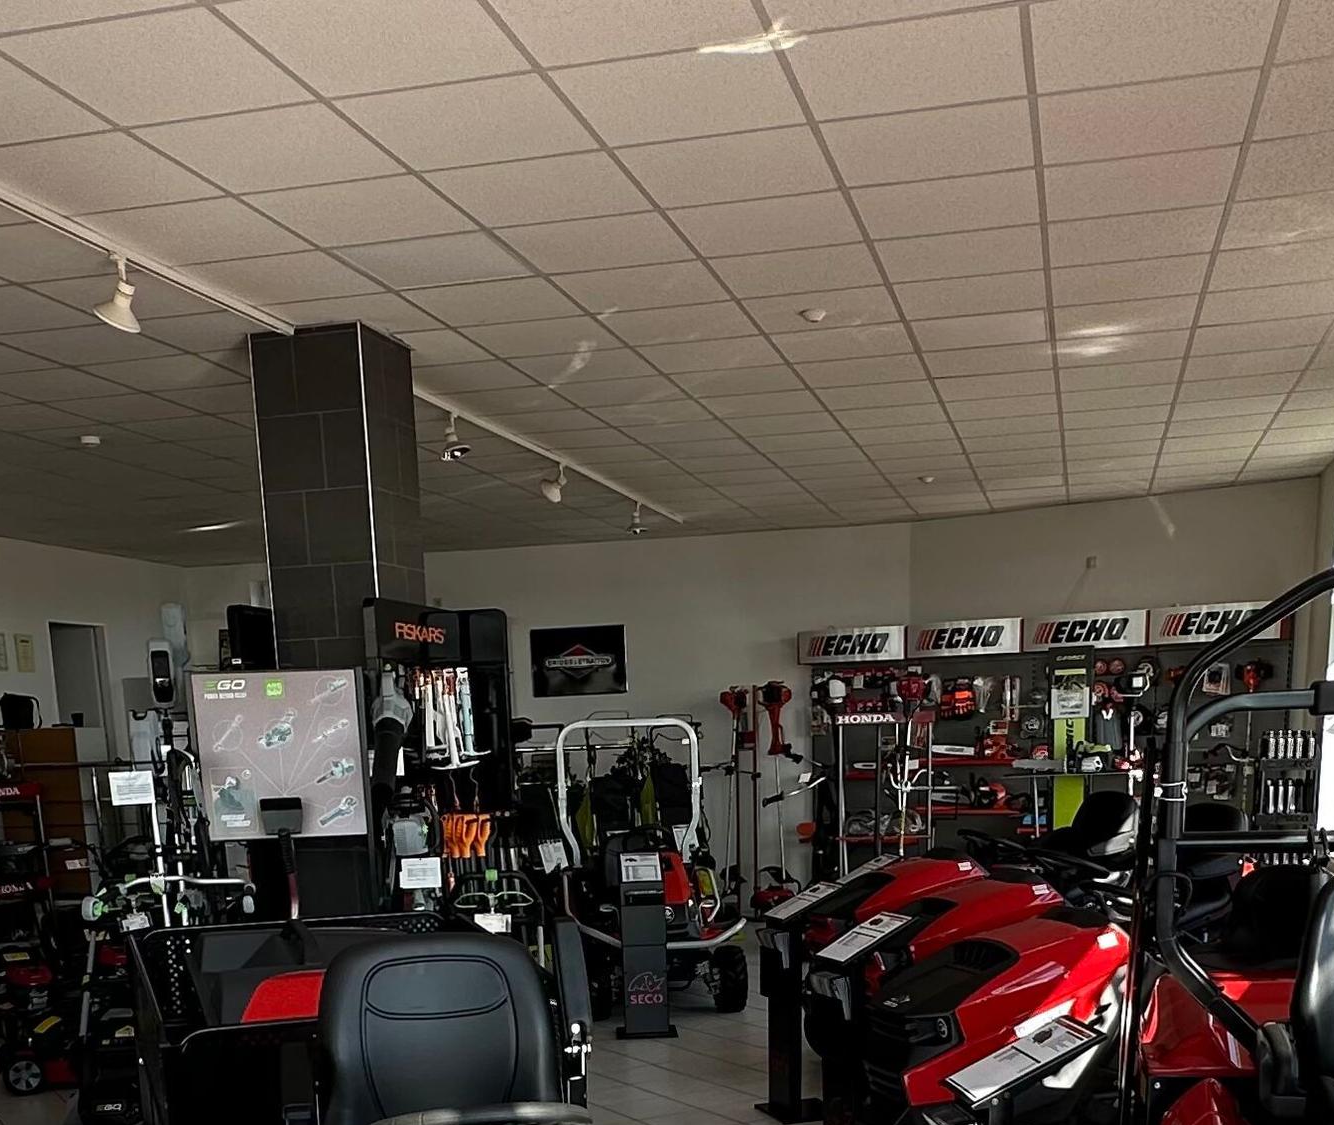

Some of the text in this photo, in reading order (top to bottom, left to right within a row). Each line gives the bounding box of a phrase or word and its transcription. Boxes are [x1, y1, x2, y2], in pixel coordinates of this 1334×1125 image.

[395, 622, 445, 645] FISKARS
[931, 625, 1004, 650] ECHO
[1049, 617, 1130, 646] ECHO
[821, 633, 889, 656] ECHO
[836, 712, 895, 725] HONDA
[630, 994, 664, 1005] SECO
